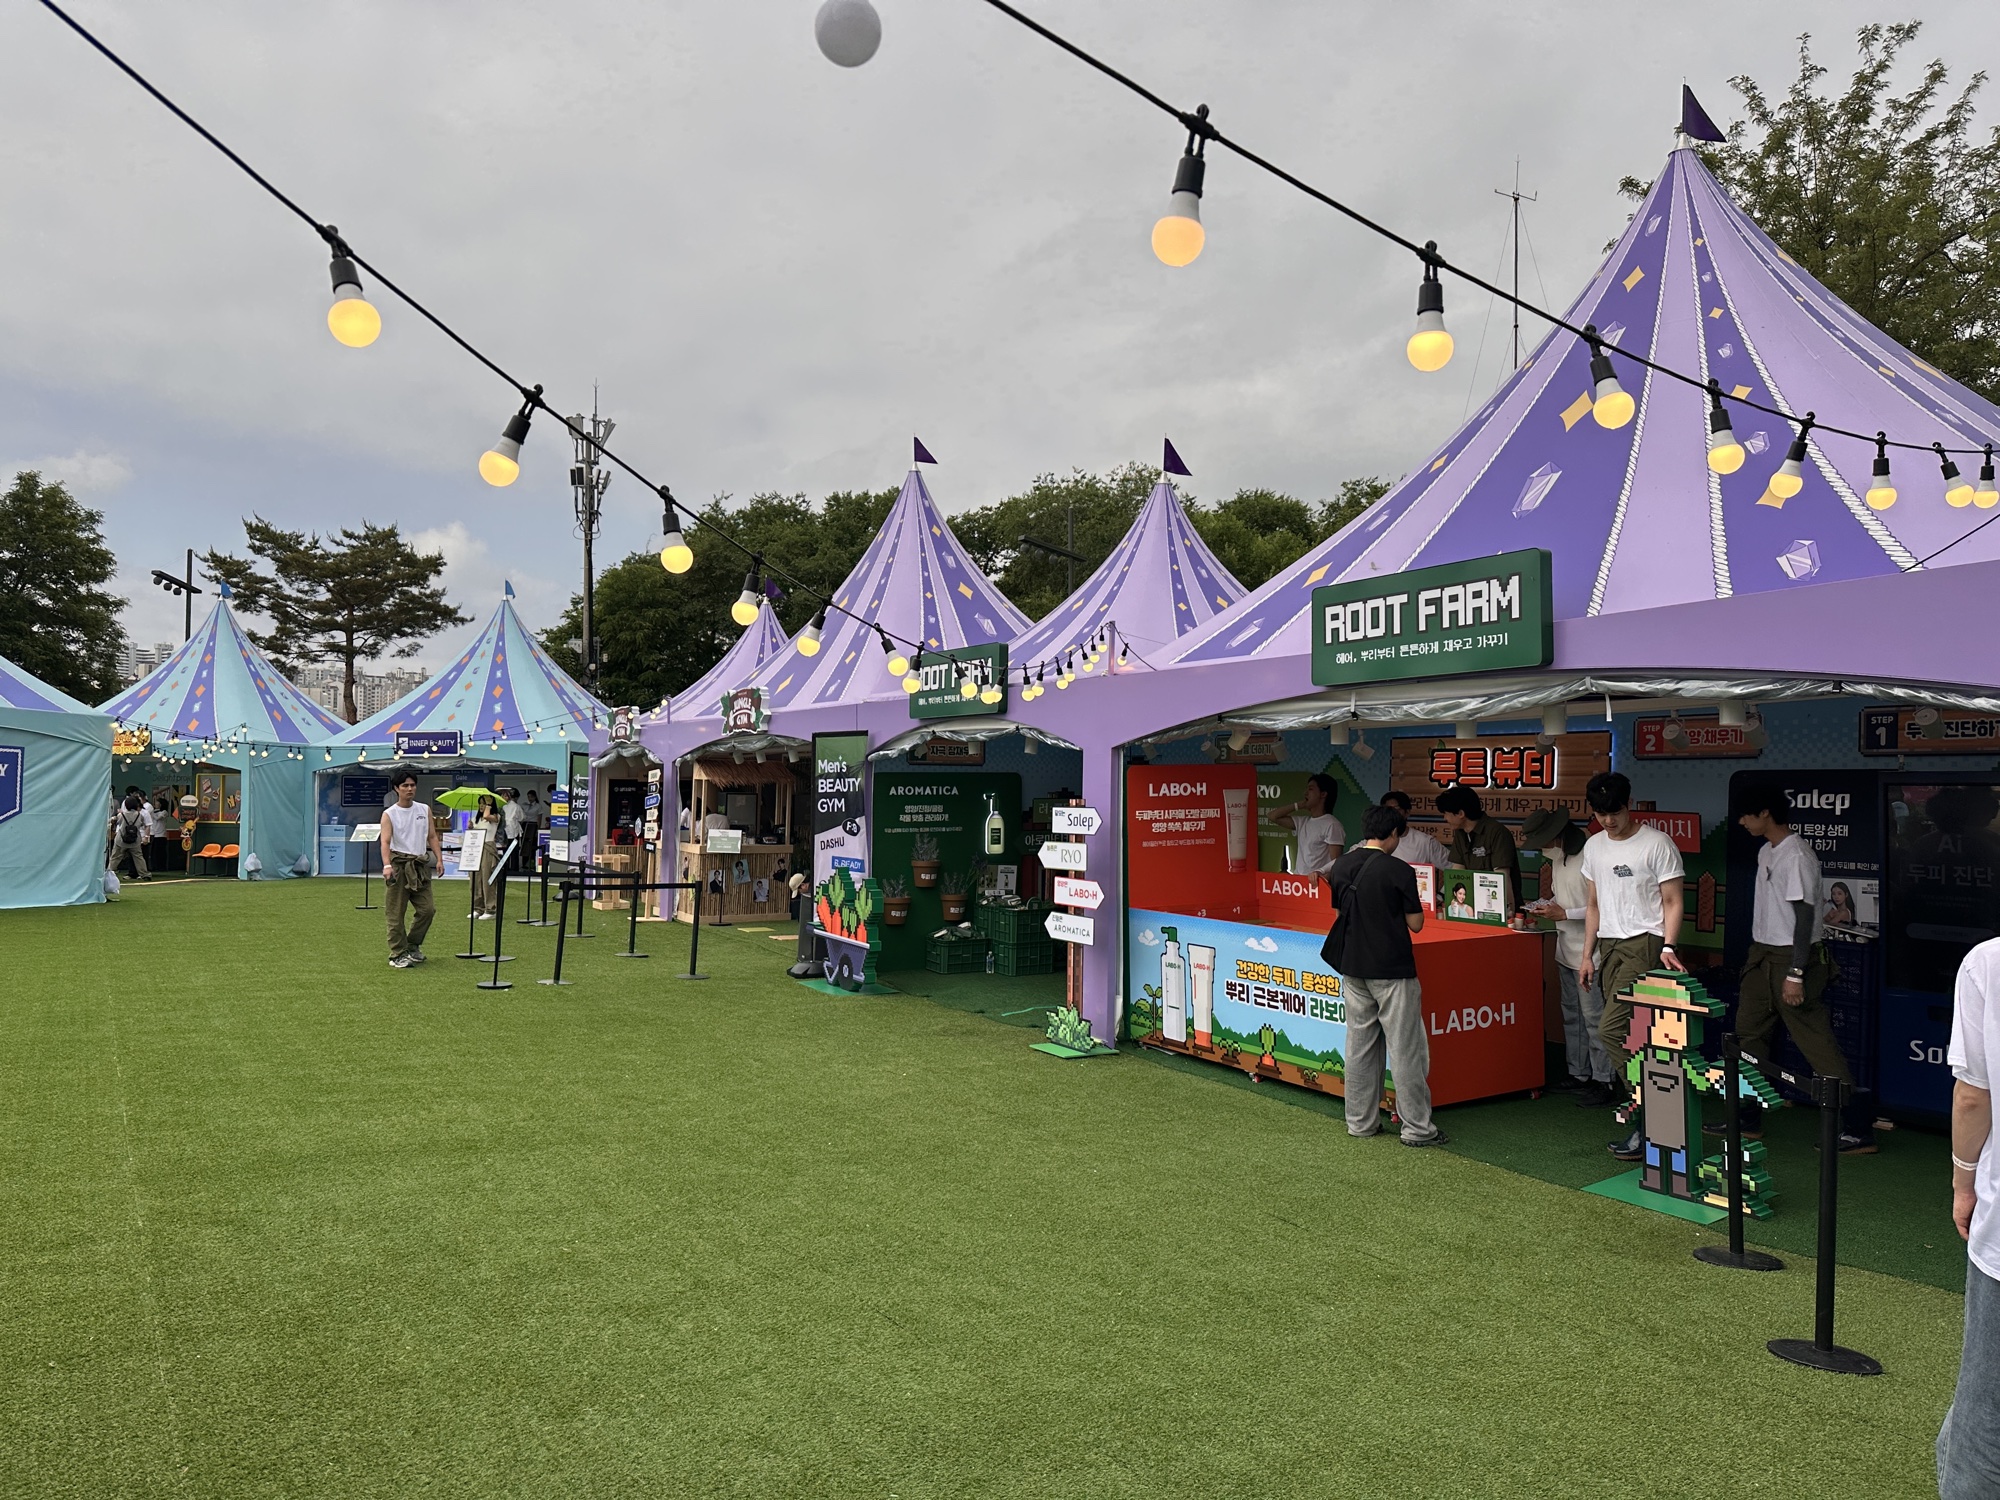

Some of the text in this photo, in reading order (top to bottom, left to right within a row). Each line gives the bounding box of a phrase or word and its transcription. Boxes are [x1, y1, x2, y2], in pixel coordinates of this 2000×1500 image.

[1325, 575, 1520, 644] ROOT FARM
[1335, 633, 1509, 664] 헤어, 뿌리부터 튼튼하게 채우고 가꾸기
[1871, 716, 1894, 724] STEP
[1645, 734, 1656, 751] 2
[1704, 728, 1744, 745] 채우기
[1876, 726, 1886, 746] 1
[1220, 747, 1228, 760] 3
[818, 756, 847, 773] Men's
[1431, 750, 1553, 786] 루트 뷰티
[818, 778, 861, 793] BEAUTY
[889, 786, 959, 796] AROMATICA
[1257, 784, 1281, 799] RYO
[818, 798, 845, 812] GYM
[1505, 797, 1542, 813] 채우고
[1784, 788, 1850, 815] Solep
[1067, 814, 1094, 831] Solep
[1135, 809, 1164, 821] 두피부터
[1152, 822, 1167, 833] 영양
[1804, 823, 1826, 837] 토양
[1827, 824, 1849, 837] 상태
[820, 837, 845, 850] DASHU
[1815, 838, 1837, 851] 하기
[1060, 848, 1082, 864] RYO
[1823, 861, 1836, 869] 나의
[1837, 862, 1856, 870] 두피를
[1907, 863, 1996, 887] 두피 진단
[1054, 924, 1091, 937] AROMATICA
[1236, 959, 1340, 997] 건강한 두피, 풍성한
[1226, 980, 1250, 1004] 뿌리
[1253, 986, 1306, 1016] 근본케어
